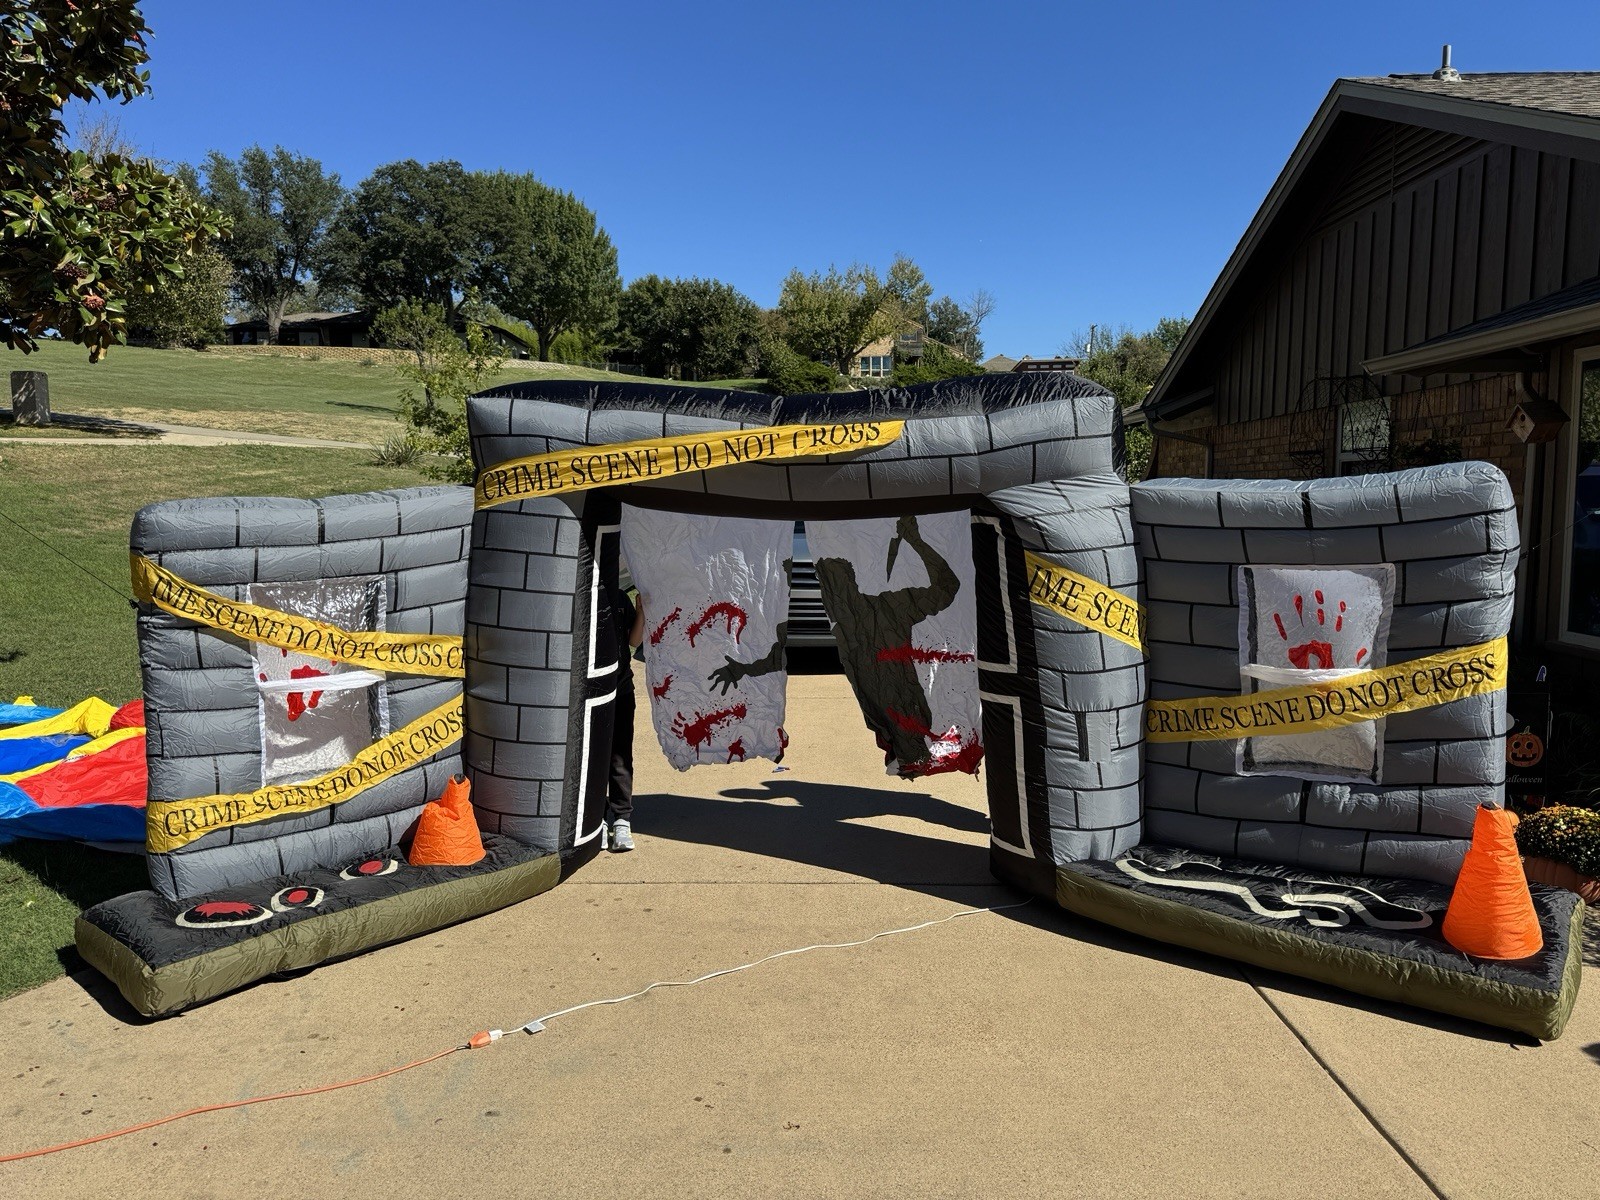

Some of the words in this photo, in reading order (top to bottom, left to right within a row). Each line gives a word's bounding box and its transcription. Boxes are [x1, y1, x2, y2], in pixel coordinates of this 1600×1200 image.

[483, 461, 563, 501] CRIME
[571, 448, 662, 486] SCENE
[673, 444, 712, 471] DO
[723, 433, 780, 463] NOT
[793, 423, 880, 450] CROSS
[151, 575, 200, 614] IME
[201, 597, 284, 640] SCENE
[287, 624, 322, 651] DO
[324, 632, 375, 659] NOT
[374, 642, 443, 667] CROSS
[1029, 565, 1085, 612] IME
[1146, 707, 1219, 733] CRIME
[1220, 697, 1304, 730] SCENE
[1305, 692, 1347, 721] DO
[1350, 675, 1406, 712] NOT
[1412, 653, 1496, 696] CROSS
[165, 799, 247, 837] CRIME
[250, 782, 330, 815] SCENE
[332, 764, 363, 796] DO
[362, 741, 408, 781] NOT
[409, 705, 466, 755] CROSS
[1506, 774, 1543, 783] alloween
